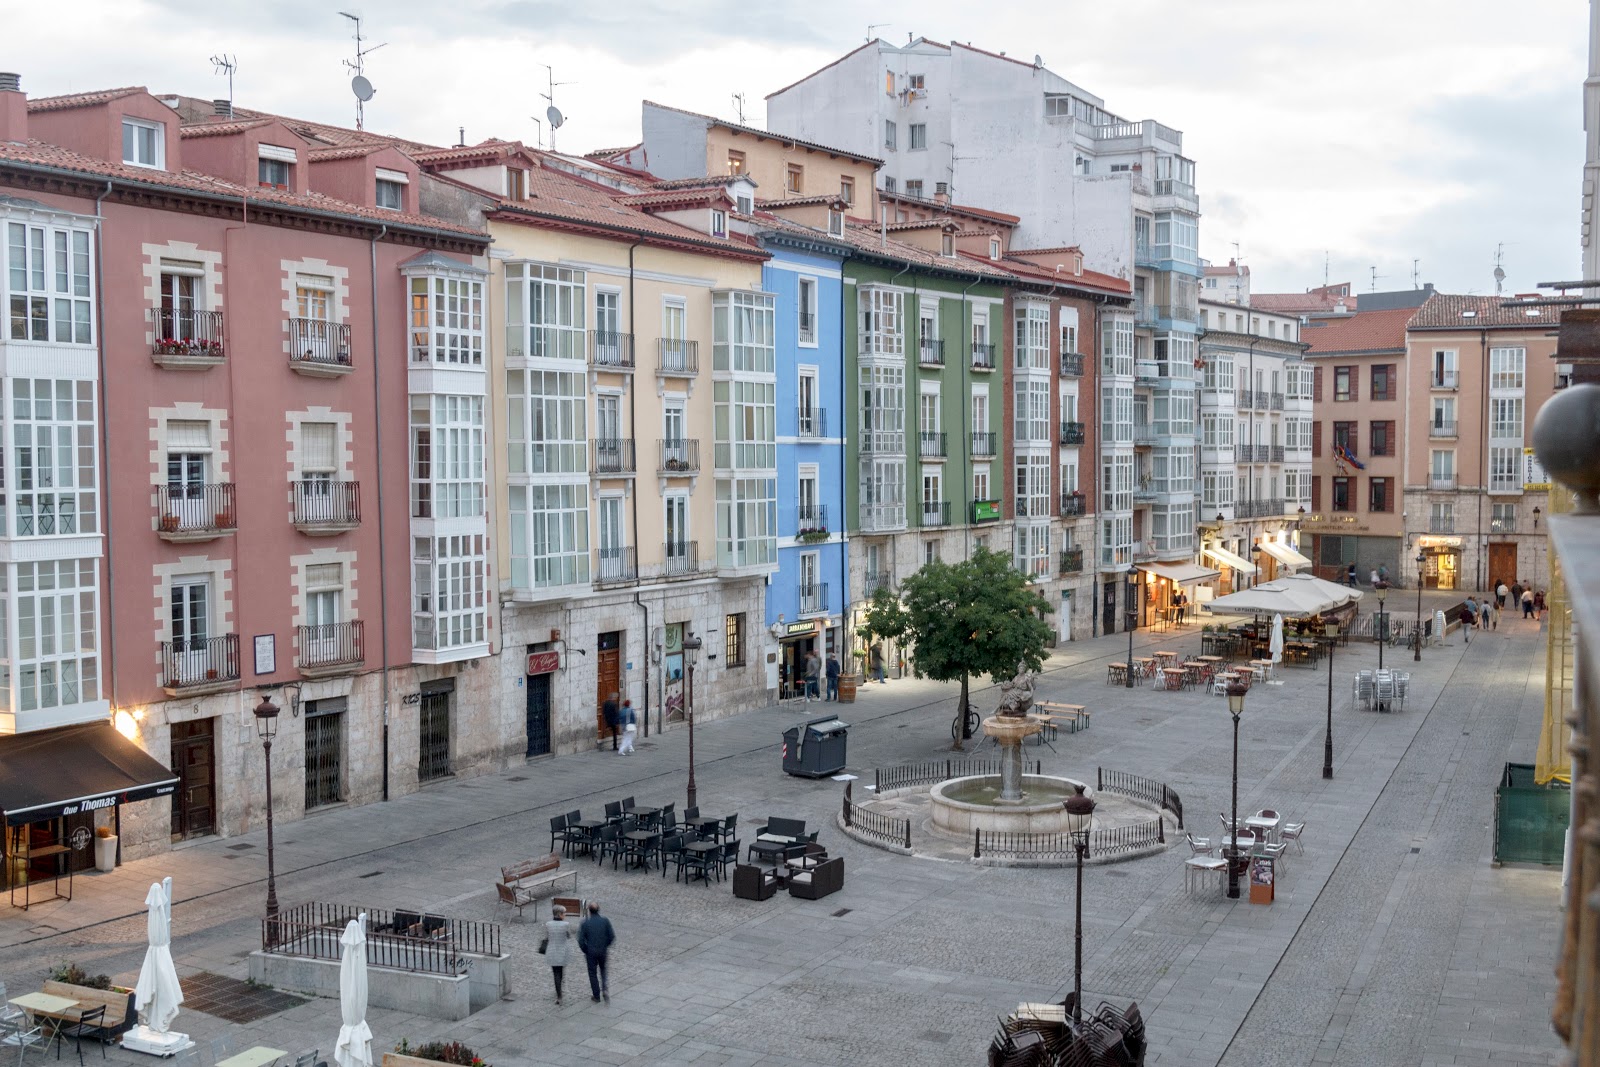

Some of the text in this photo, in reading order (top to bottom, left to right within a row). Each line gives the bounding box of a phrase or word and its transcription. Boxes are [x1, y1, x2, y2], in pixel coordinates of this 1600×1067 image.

[193, 704, 199, 714] 8
[63, 796, 116, 815] Que Thomas
